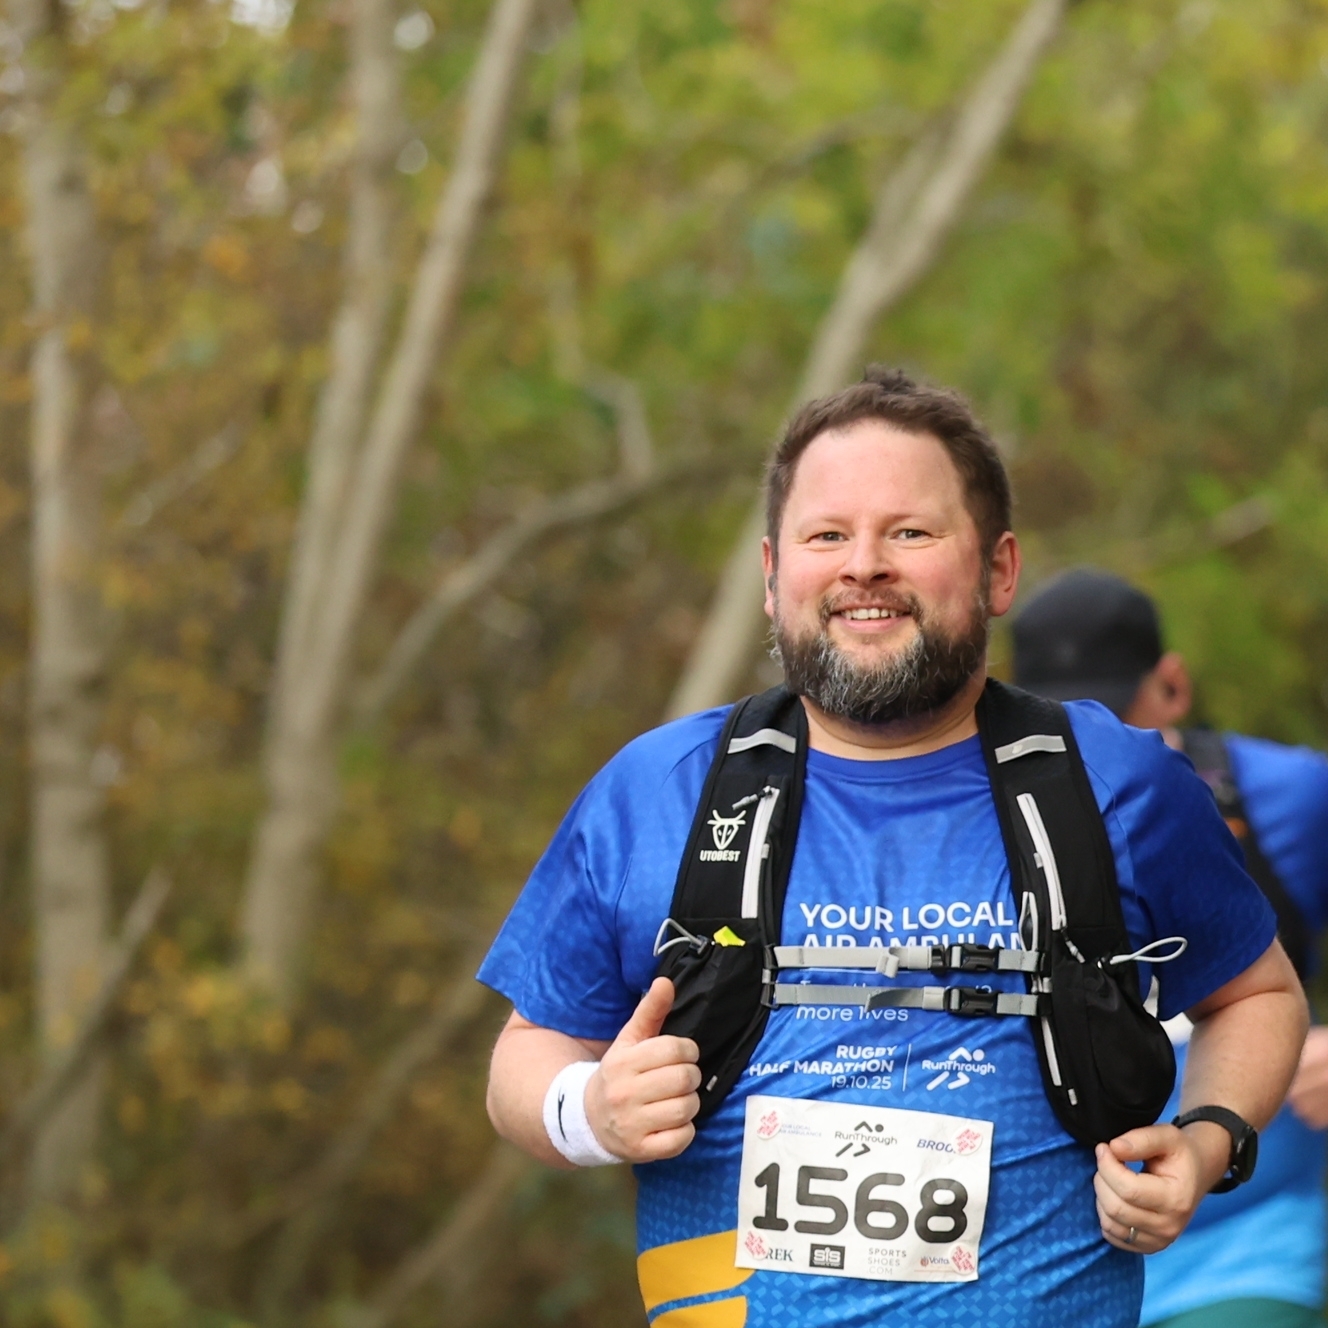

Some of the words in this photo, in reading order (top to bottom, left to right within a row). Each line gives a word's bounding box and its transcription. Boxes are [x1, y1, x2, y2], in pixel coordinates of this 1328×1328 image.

[699, 850, 741, 862] UTOBEST
[800, 903, 894, 932] YOUR
[903, 901, 1014, 930] LOCAL
[795, 1006, 853, 1022] more
[858, 1005, 909, 1022] lives
[836, 1044, 898, 1059] RUGBY
[748, 1060, 791, 1077] HALF
[793, 1059, 895, 1074] MARATHON
[922, 1059, 996, 1075] RunThrough
[831, 1075, 892, 1090] 19.10.25
[835, 1131, 898, 1145] RunThrough
[917, 1138, 955, 1153] BROO
[752, 1162, 968, 1244] 1568
[765, 1247, 794, 1262] REK
[868, 1247, 907, 1258] SPORTS
[867, 1256, 901, 1266] SHOES
[928, 1256, 950, 1265] Volta
